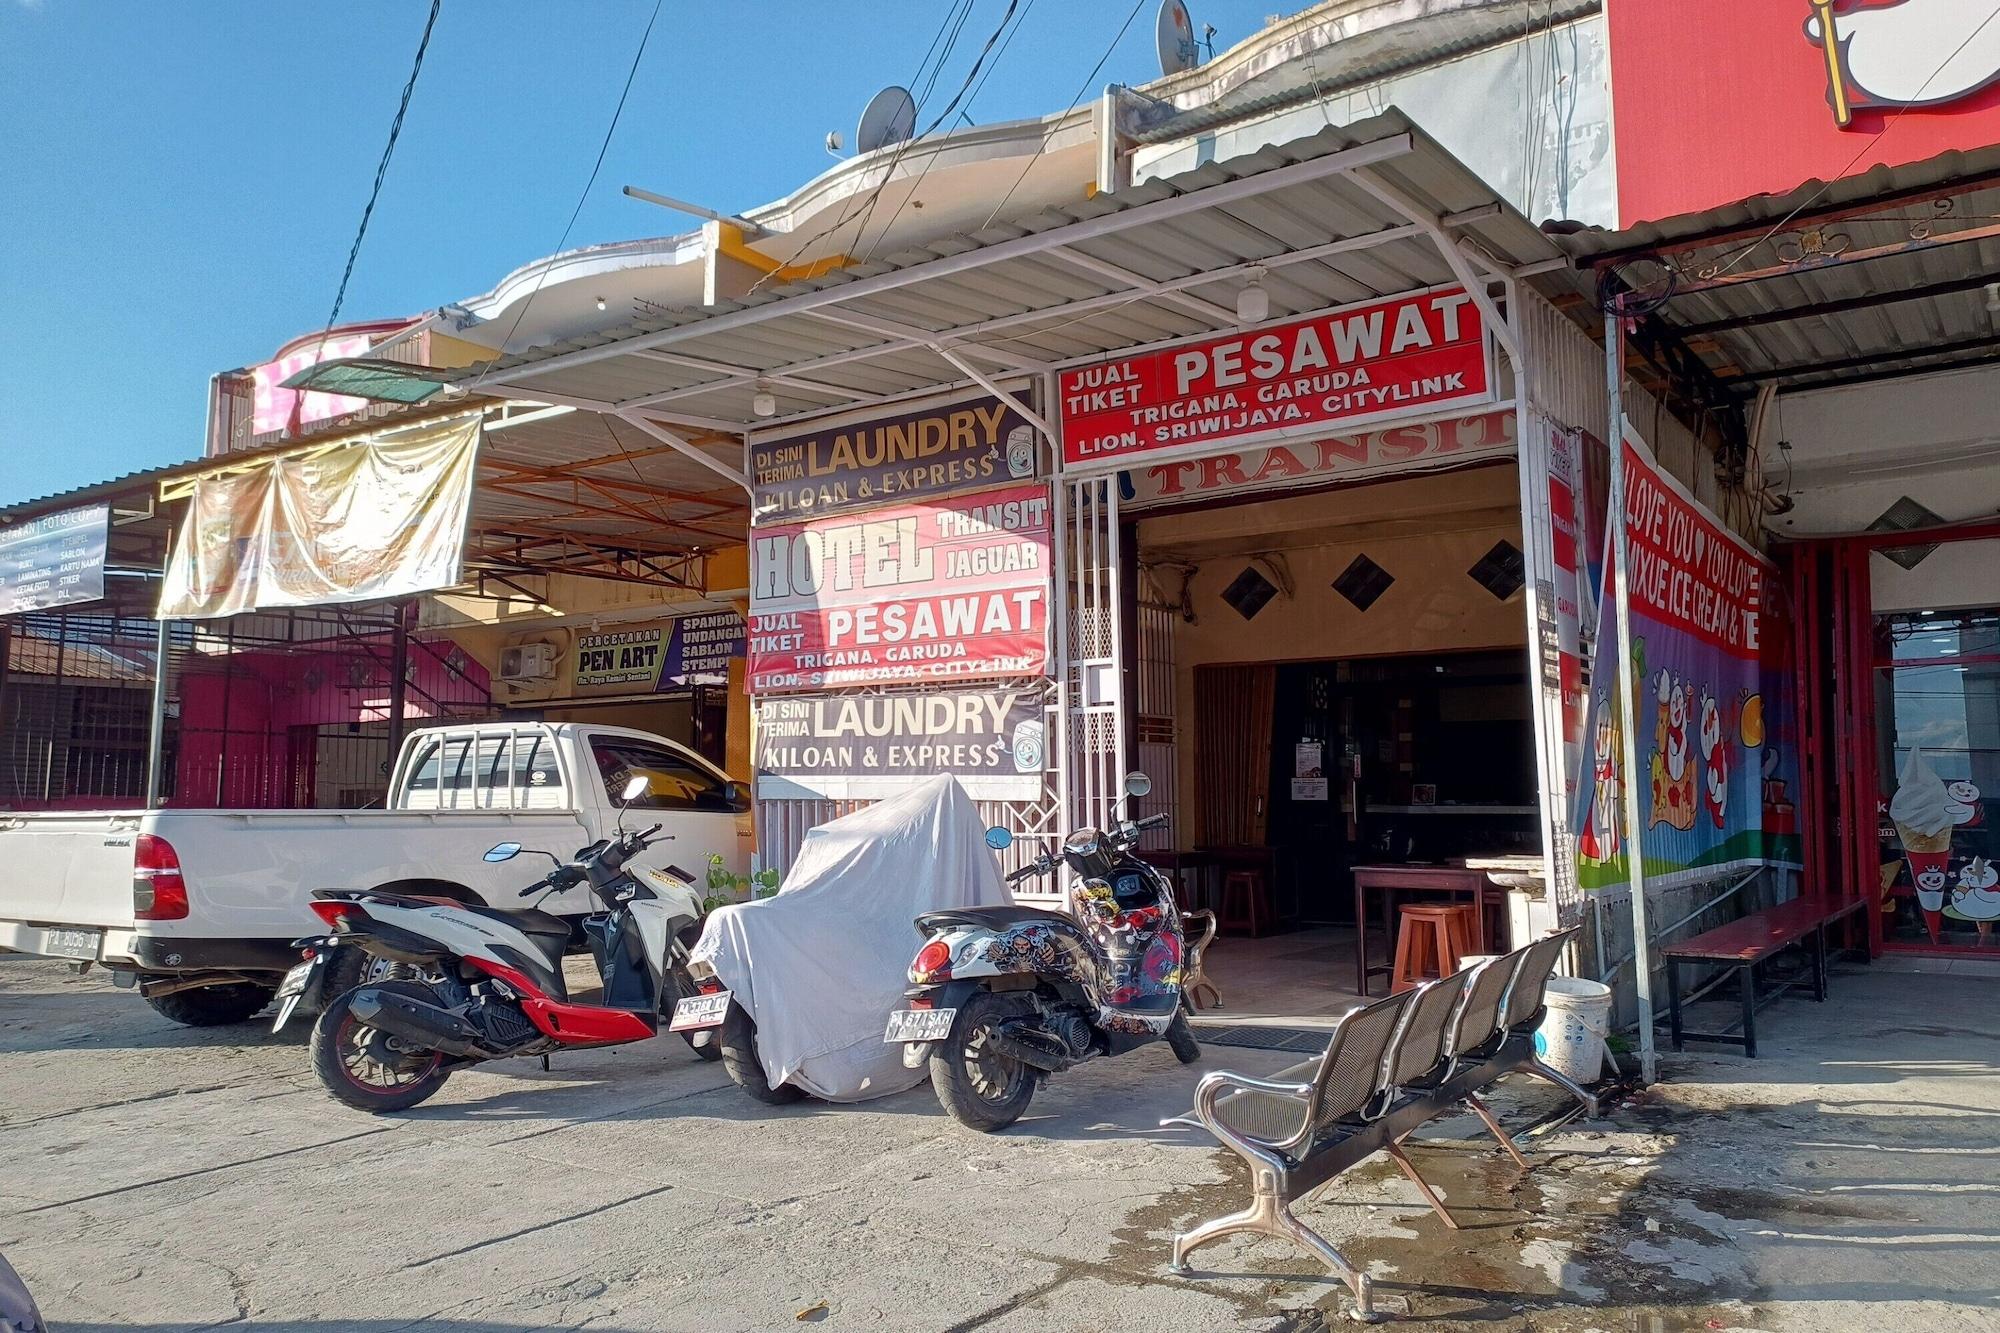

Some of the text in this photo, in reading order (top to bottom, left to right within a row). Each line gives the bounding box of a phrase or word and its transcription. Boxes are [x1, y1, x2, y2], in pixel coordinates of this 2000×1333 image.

[1174, 295, 1472, 395] PESAWAT
[1070, 362, 1138, 392] JUAL
[1067, 384, 1143, 415] TIKET
[1130, 367, 1370, 426] TRIGANA, GARUDA
[1079, 372, 1466, 455] LION, SRIWIJAYA, CITYLINK
[808, 403, 1008, 477] LAUNDRY
[1147, 408, 1517, 496] TRANSIT
[756, 445, 803, 469] DI SINI
[757, 462, 804, 486] TERIMA
[765, 456, 994, 512] KILOAN & EXPRESS
[936, 498, 1048, 538] TRANSIT
[1626, 467, 1666, 546] LOVE
[1665, 501, 1695, 564] YOU
[1706, 534, 1729, 588] YOU
[755, 516, 935, 601] HOTEL
[945, 541, 1039, 579] JAGUAR
[1626, 535, 1670, 609] MIXUE
[1669, 567, 1692, 620] ICE
[1693, 580, 1729, 640] CREAM
[1729, 605, 1738, 646] &
[752, 613, 802, 633] JUAL
[829, 591, 1040, 647] PESAWAT
[579, 629, 661, 648] PERCETAKAN
[682, 642, 733, 657] SABLON
[750, 633, 804, 653] TIKET
[578, 645, 659, 672] PEN ART
[682, 657, 729, 671] STEMP
[794, 642, 967, 669] TRIGANA, GARUDA
[755, 673, 802, 689] LION,
[930, 656, 1031, 676] CITYLINK
[762, 702, 809, 719] DI SINI
[814, 694, 1016, 737] LAUNDRY
[761, 721, 809, 738] TERIMA
[766, 744, 1000, 768] KILOAN & EXPRESS
